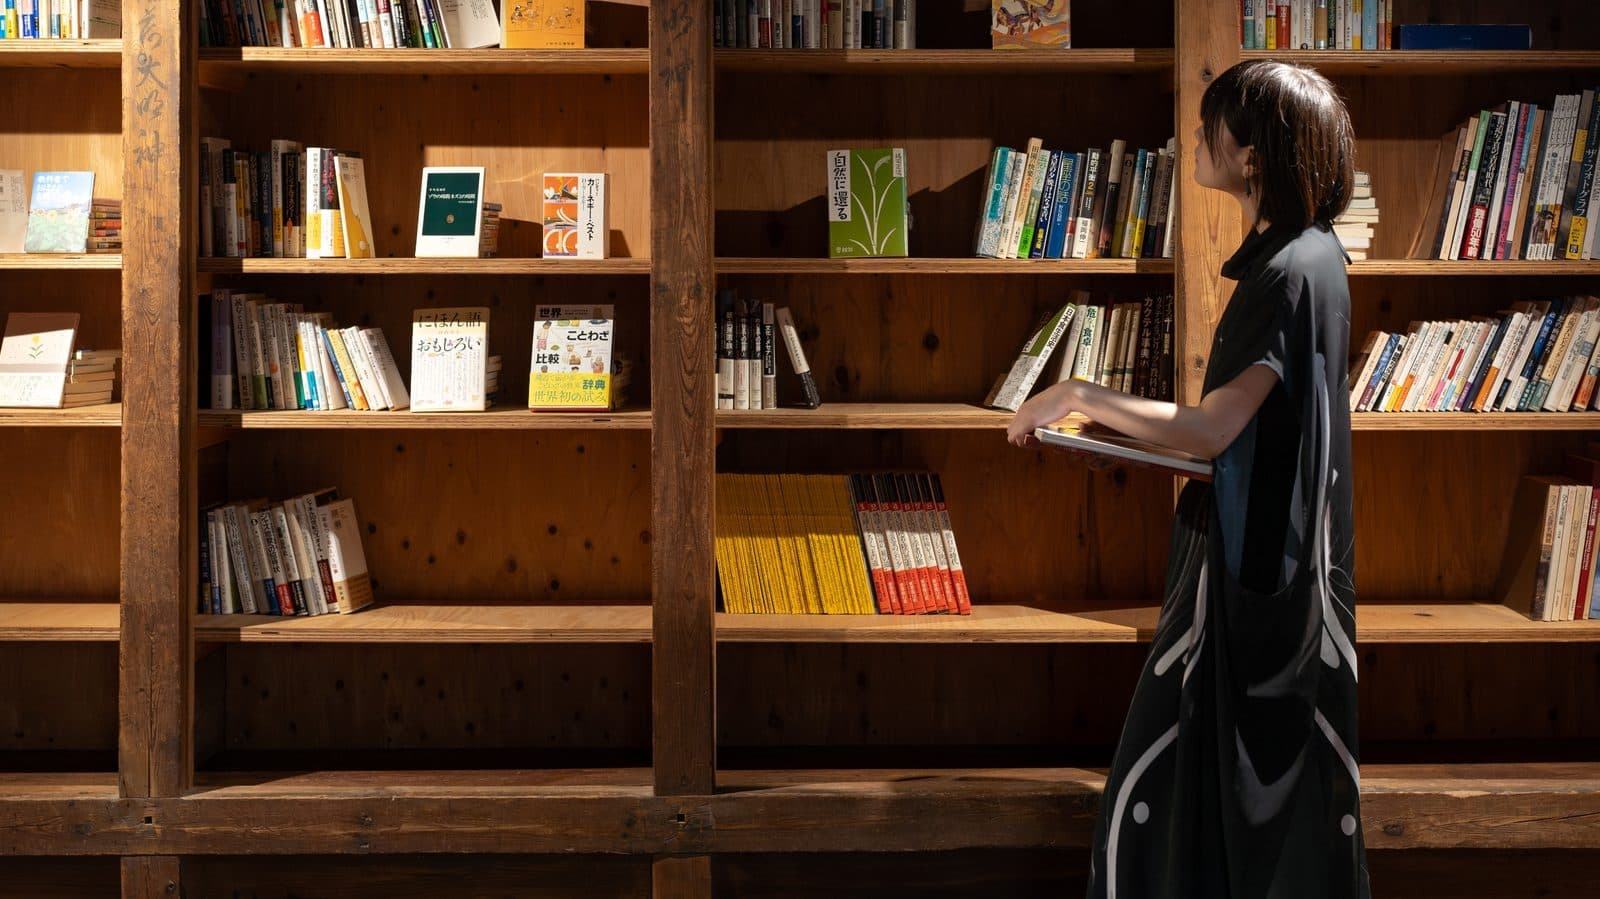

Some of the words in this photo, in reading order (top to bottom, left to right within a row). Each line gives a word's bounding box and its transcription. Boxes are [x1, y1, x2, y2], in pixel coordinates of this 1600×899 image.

[833, 152, 848, 220] 自然に還る
[586, 178, 595, 241] カーネギー・ベスト
[418, 311, 481, 328] にほん語
[539, 307, 562, 318] 世界
[1046, 307, 1074, 349] 日本食生活史
[567, 330, 609, 341] ことわざ
[417, 337, 481, 353] おもしろい
[536, 353, 560, 364] 比較
[582, 379, 606, 390] 辞典
[534, 390, 606, 403] 世界初の試み
